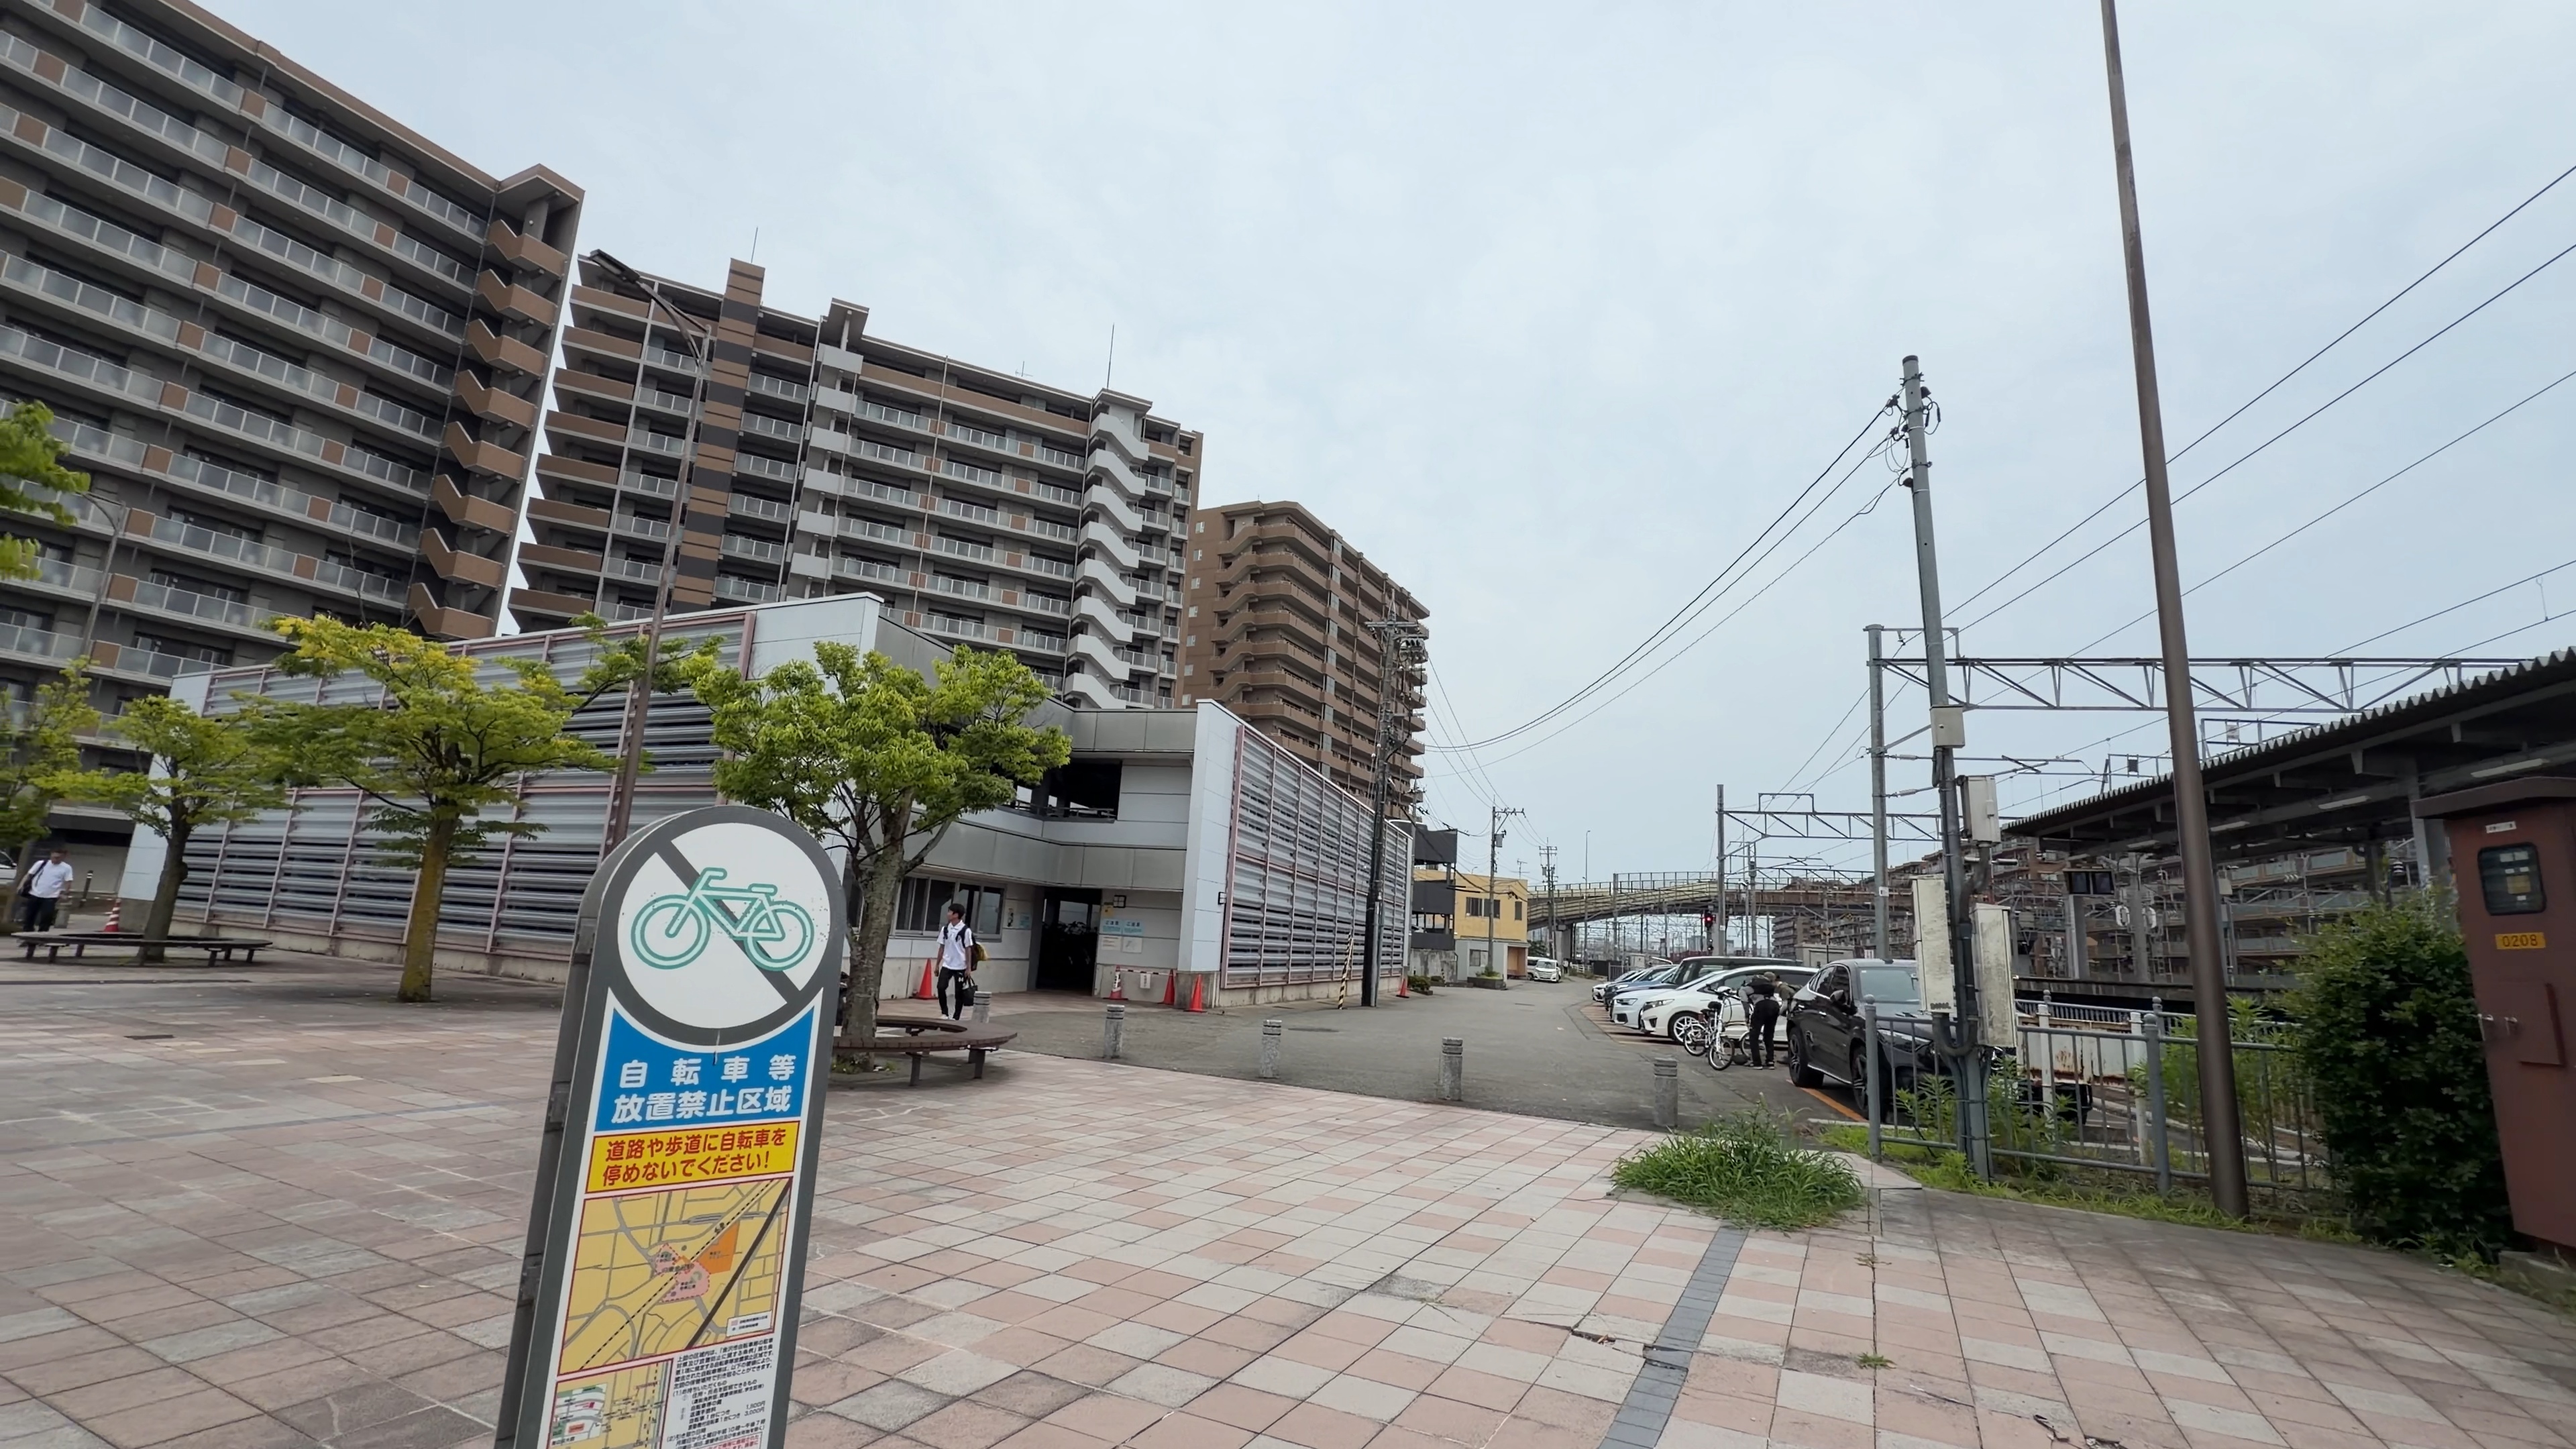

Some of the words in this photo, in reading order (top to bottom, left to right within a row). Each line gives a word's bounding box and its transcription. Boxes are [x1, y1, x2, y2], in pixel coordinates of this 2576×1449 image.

[2502, 934, 2538, 947] 0208
[619, 1054, 796, 1088] 自転車等
[611, 1085, 792, 1124] 放置禁止区域
[606, 1128, 786, 1161] 道路や歩道に自転車を
[602, 1150, 769, 1187] 停めないでください!
